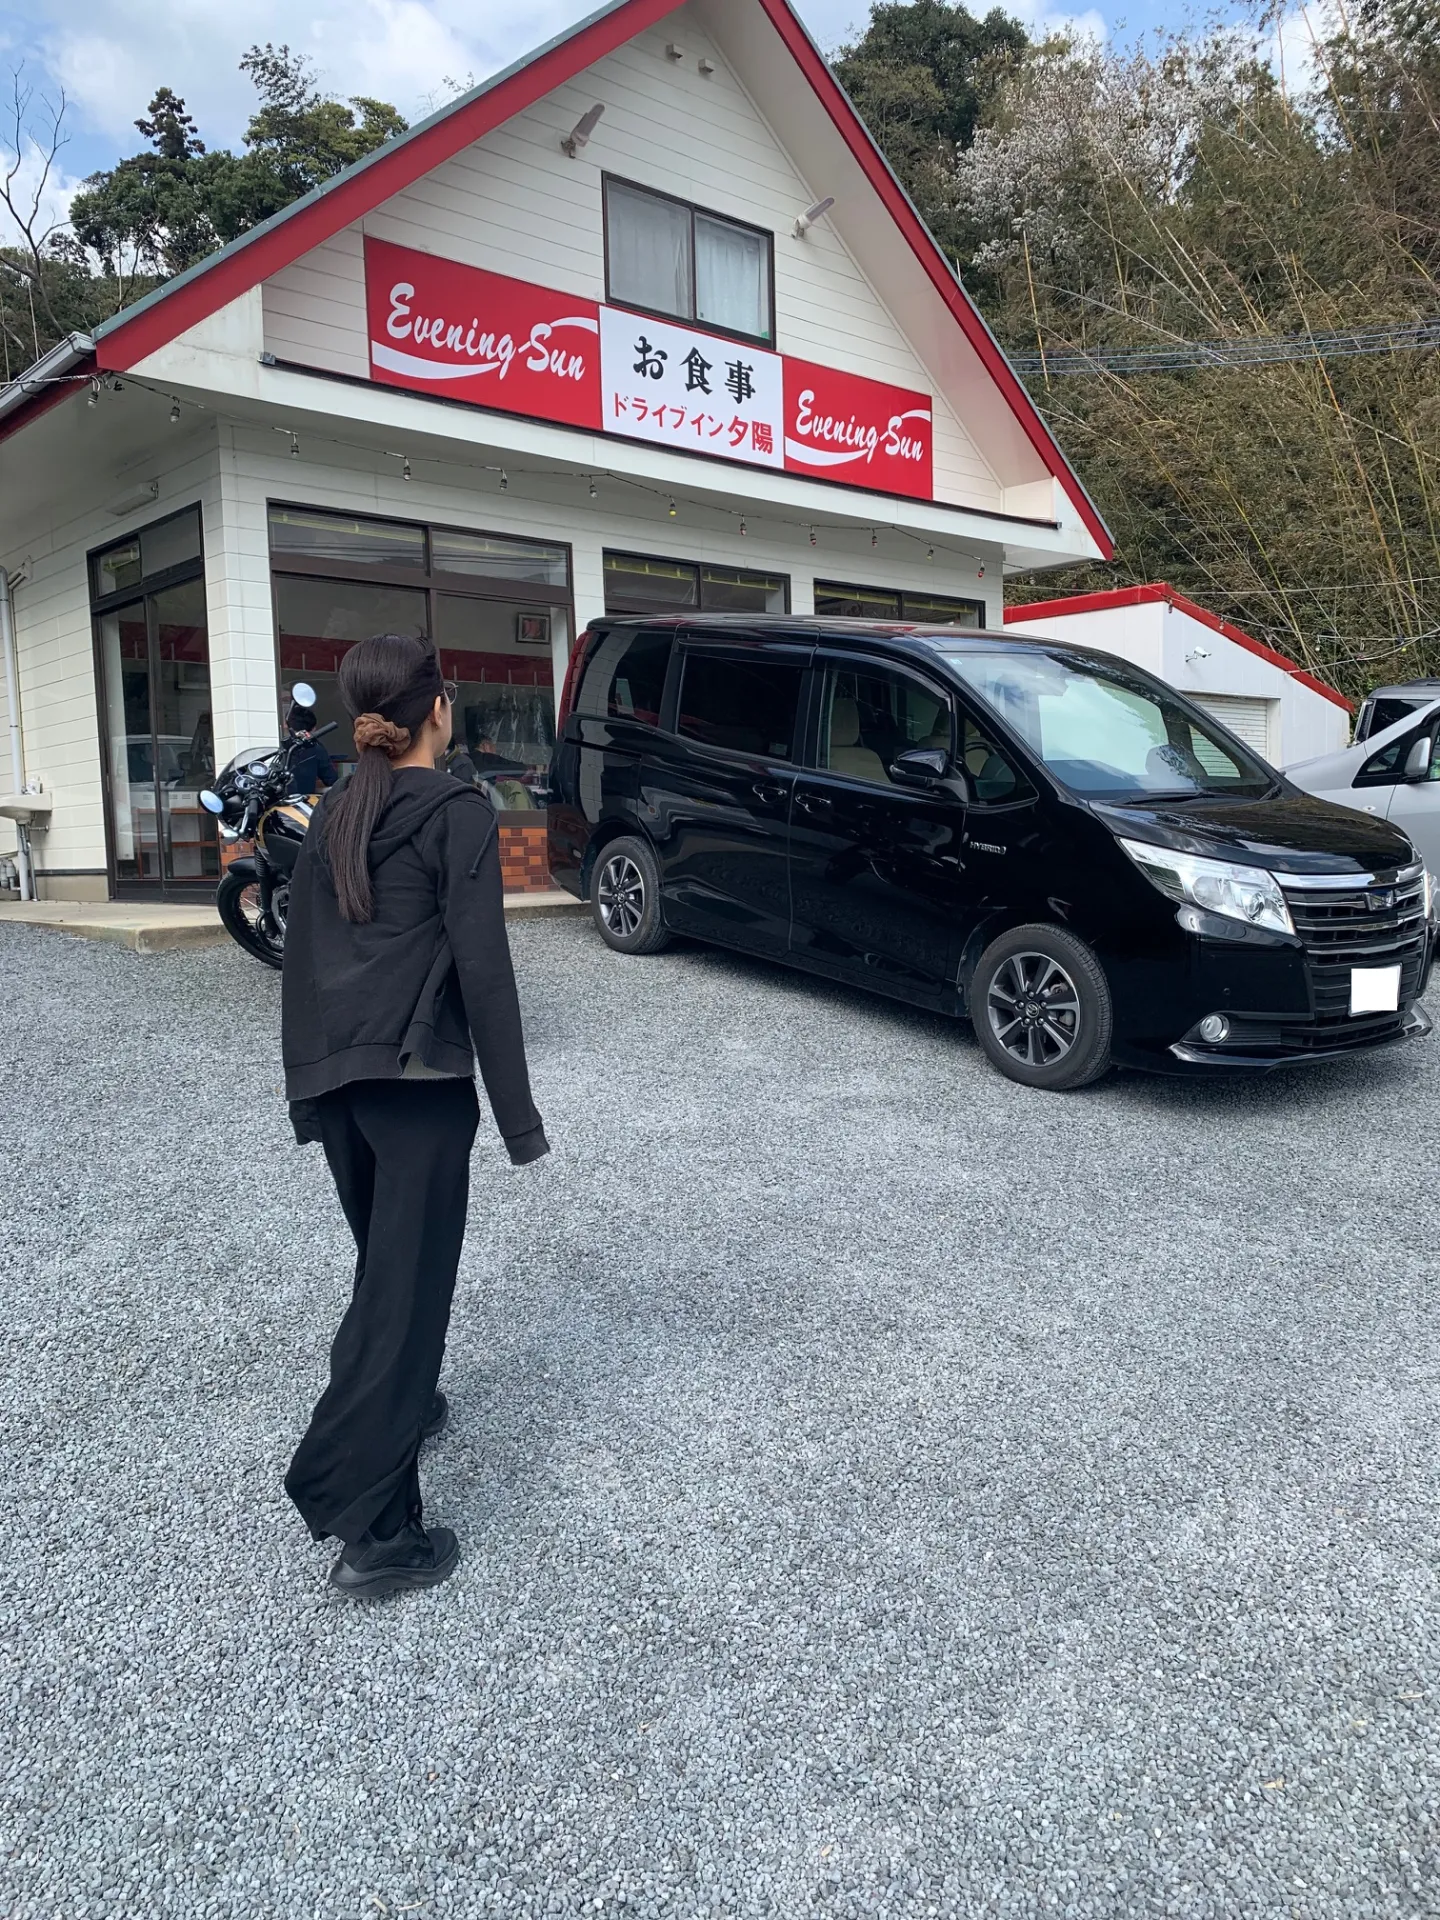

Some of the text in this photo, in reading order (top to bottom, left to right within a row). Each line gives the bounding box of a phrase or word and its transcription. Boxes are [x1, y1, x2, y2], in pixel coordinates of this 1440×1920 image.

[632, 335, 756, 405] お食事
[613, 392, 774, 455] ドライブイン夕陽
[969, 840, 1007, 855] HYBRID
